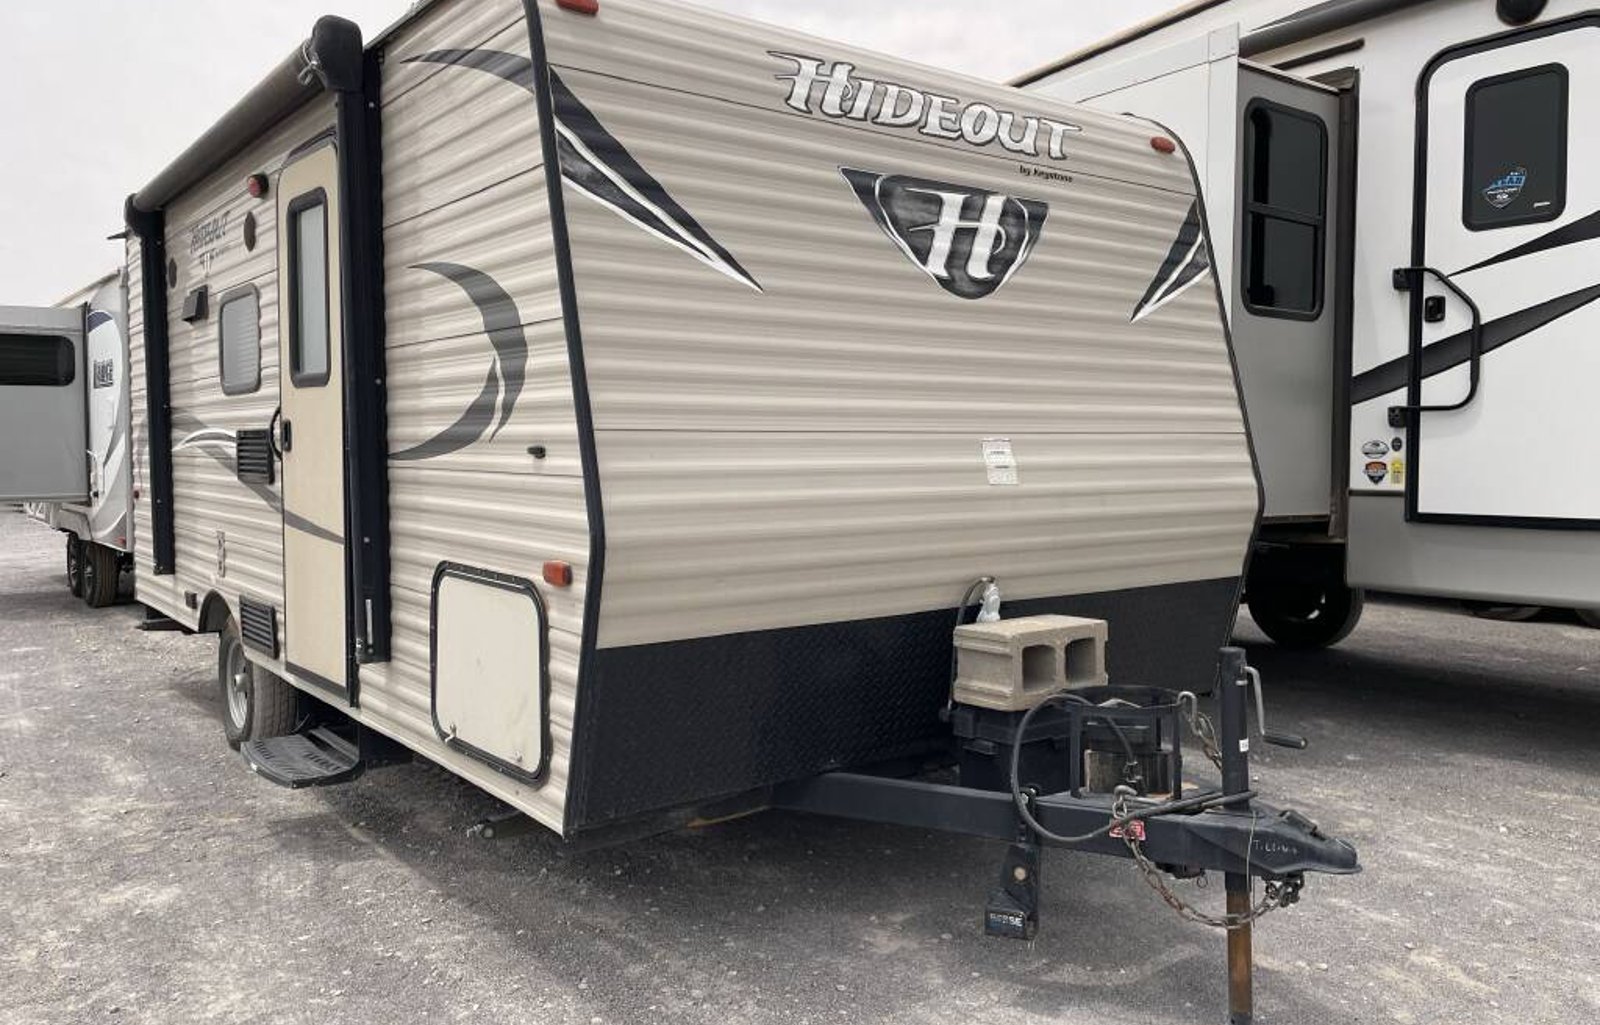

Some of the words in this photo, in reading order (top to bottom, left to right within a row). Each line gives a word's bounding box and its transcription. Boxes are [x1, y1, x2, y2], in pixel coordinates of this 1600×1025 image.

[766, 51, 1082, 160] HIDEOUT
[1019, 164, 1031, 177] by
[1033, 167, 1073, 183] Keystone
